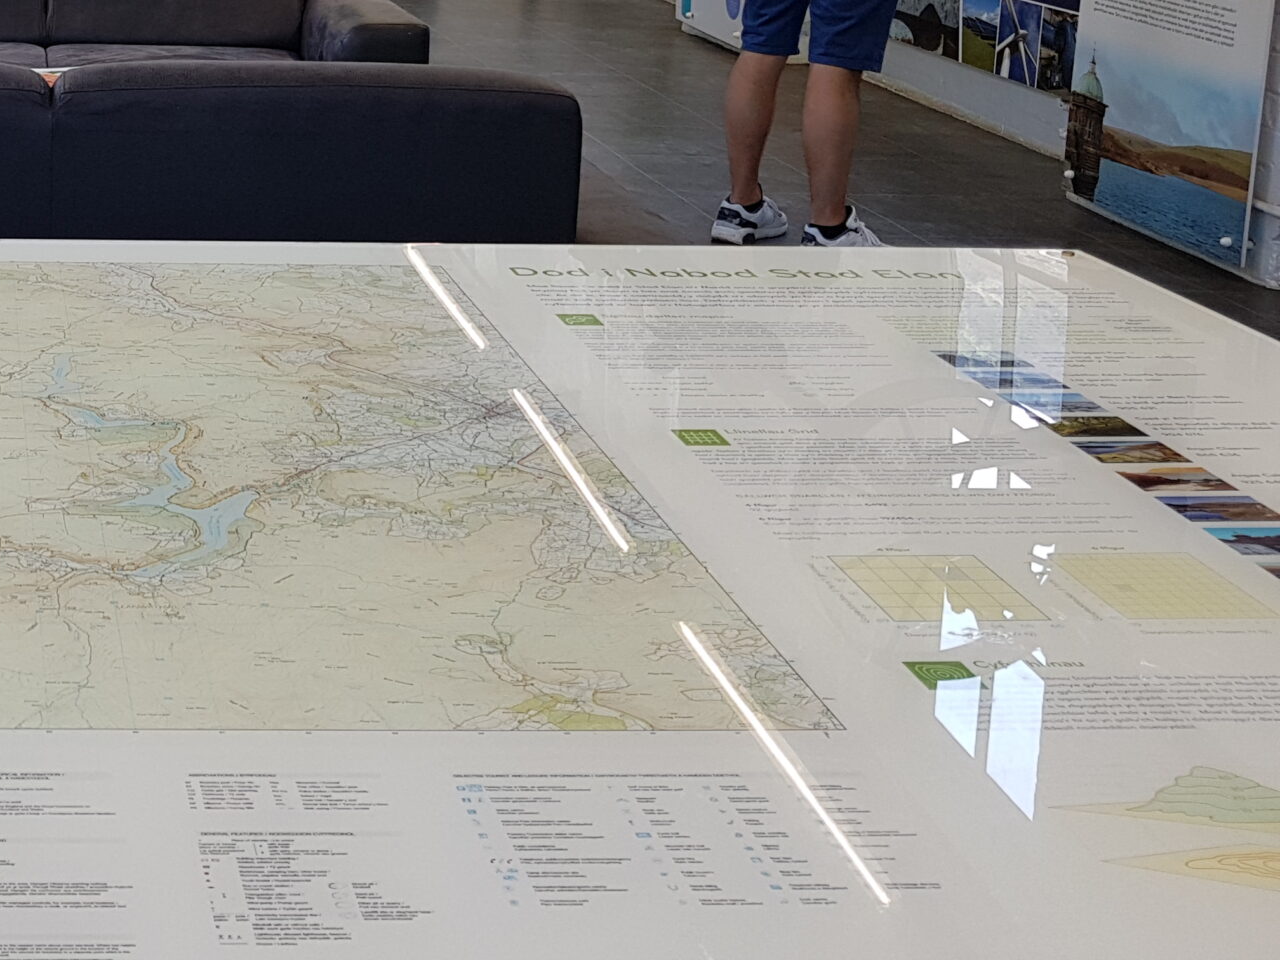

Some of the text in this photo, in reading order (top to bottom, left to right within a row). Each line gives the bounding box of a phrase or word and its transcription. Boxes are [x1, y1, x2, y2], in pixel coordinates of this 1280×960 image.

[509, 266, 964, 280] Dod i Nabod Stad Elan
